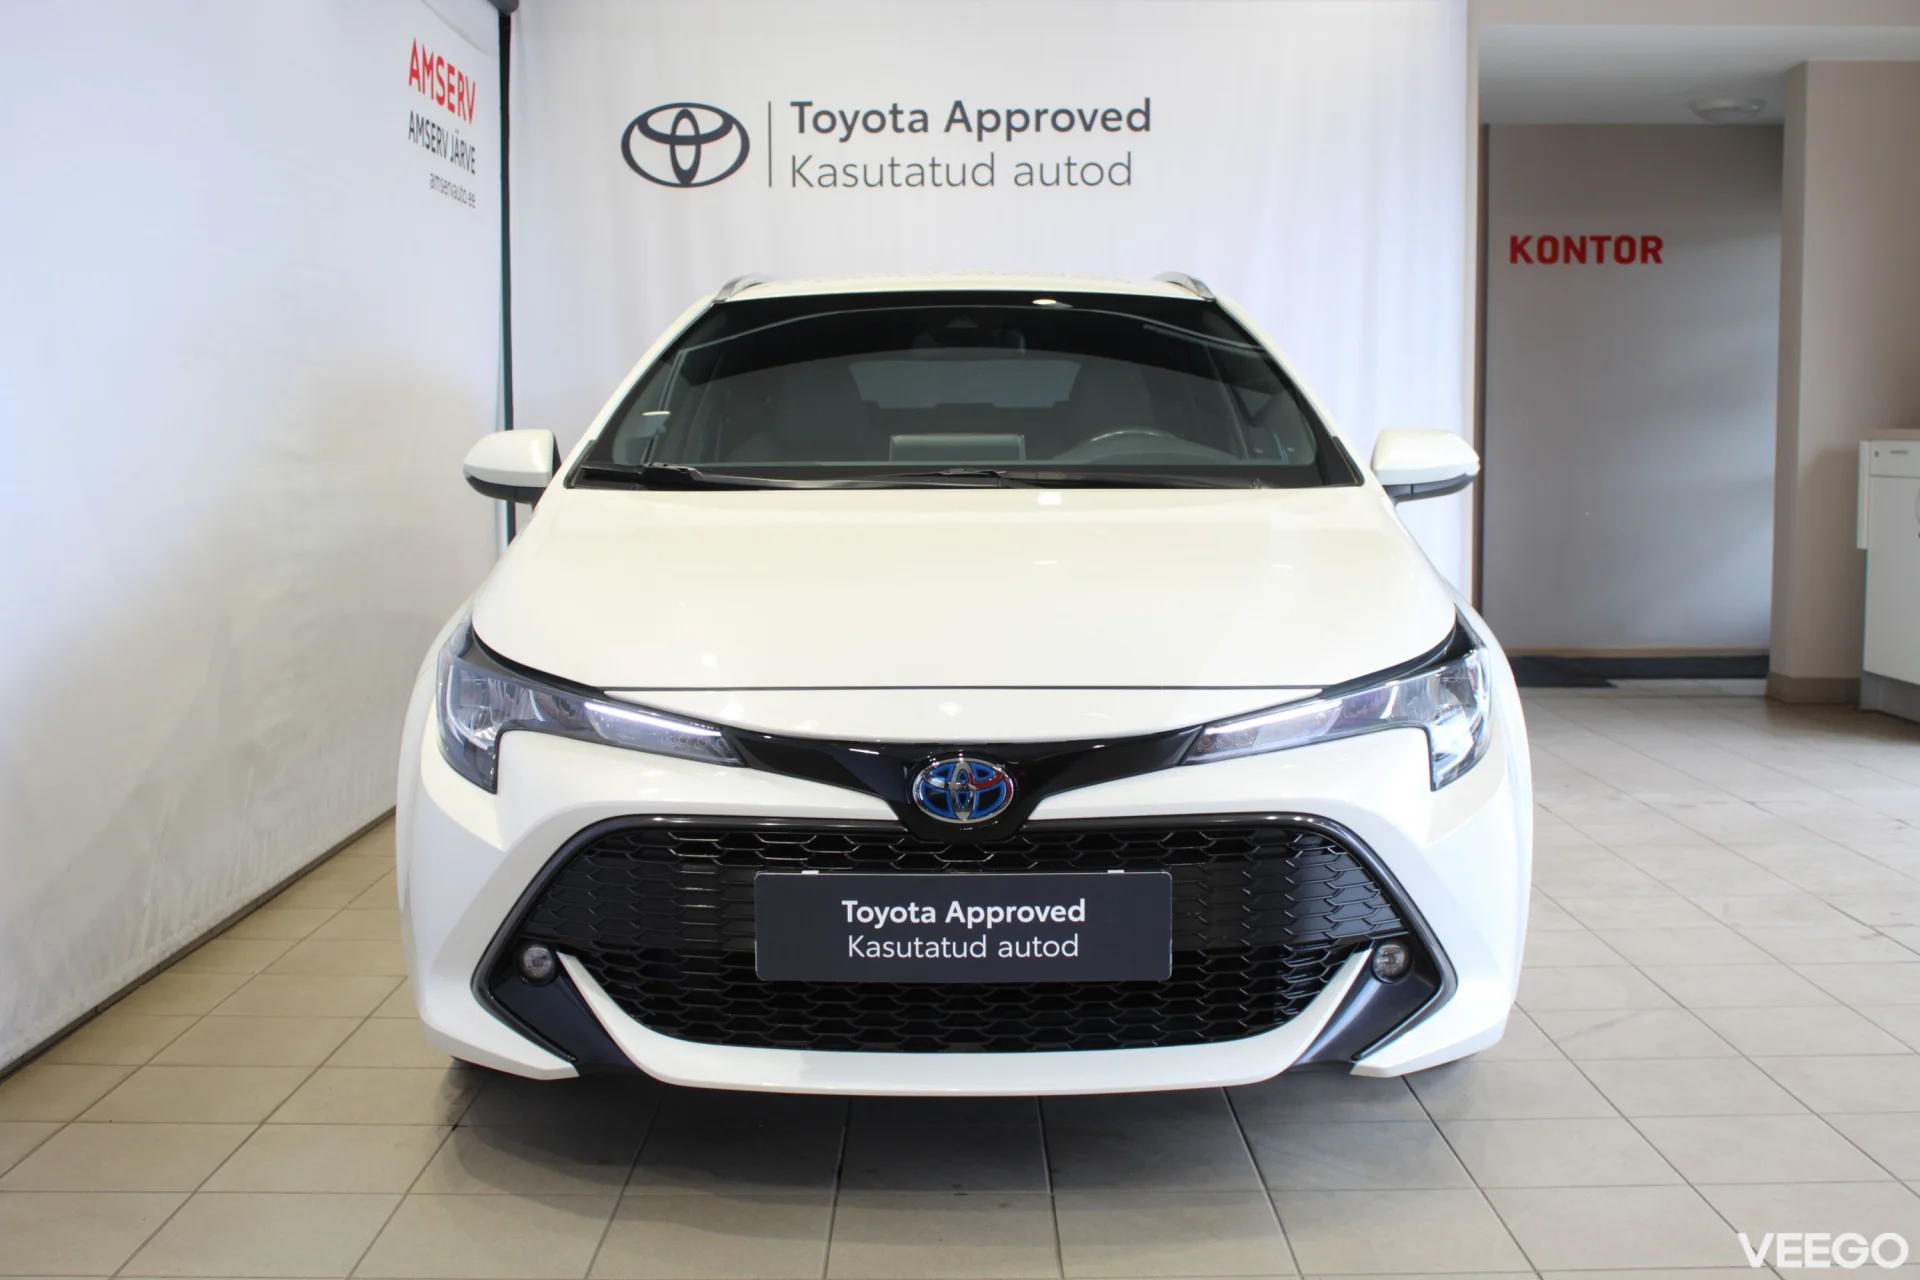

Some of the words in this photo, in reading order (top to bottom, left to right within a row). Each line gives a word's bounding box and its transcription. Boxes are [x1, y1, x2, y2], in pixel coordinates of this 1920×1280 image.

[408, 37, 476, 124] AMSERV
[790, 101, 929, 142] Toyota
[944, 98, 1151, 142] Approved
[408, 110, 449, 159] AMSERV
[450, 128, 476, 175] JÄRVE
[791, 152, 995, 188] Kasutatud
[1013, 151, 1132, 187] autod
[1509, 234, 1664, 265] KONTOR
[841, 899, 936, 929] Toyota
[945, 898, 1086, 928] Approved
[848, 934, 987, 958] Kasutatud
[998, 933, 1079, 958] autod
